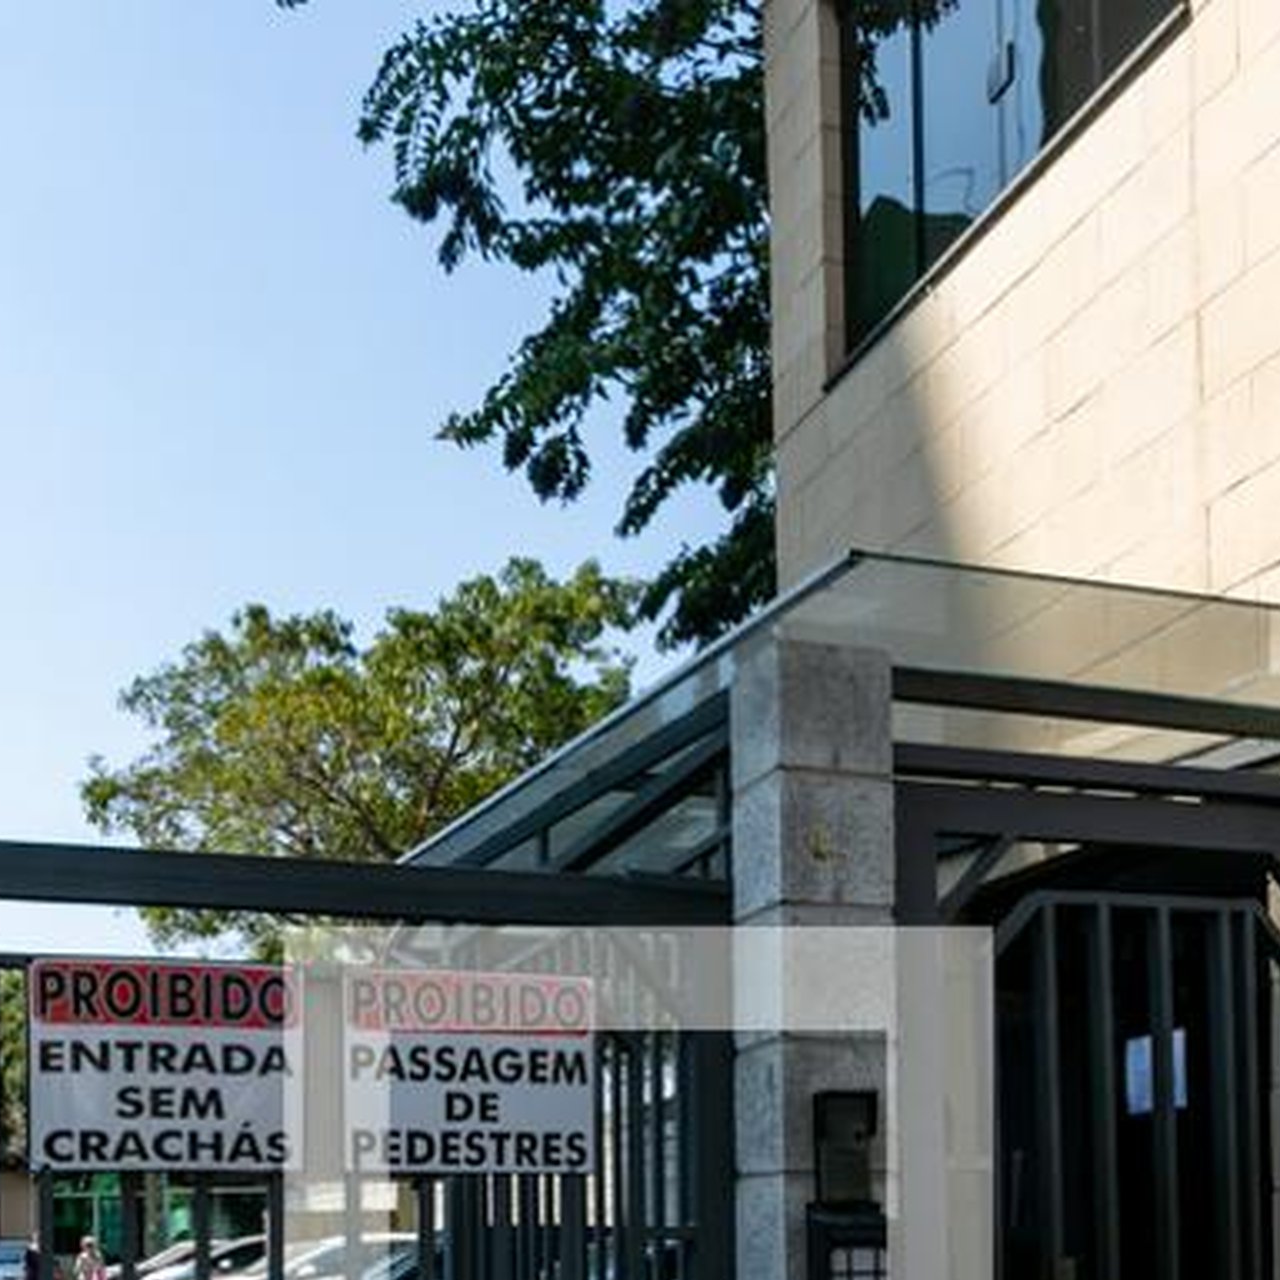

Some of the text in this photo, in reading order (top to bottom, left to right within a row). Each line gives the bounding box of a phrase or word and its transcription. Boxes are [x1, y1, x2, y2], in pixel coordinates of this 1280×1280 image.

[38, 970, 293, 1022] PROIBIDO
[352, 980, 585, 1028] PROIBIDO
[38, 1040, 293, 1076] ENTRADA
[350, 1045, 588, 1085] PASSAGEM
[116, 1086, 225, 1120] SEM
[445, 1091, 501, 1123] DE
[43, 1121, 291, 1163] CRACHÁS
[352, 1130, 588, 1168] PEDESTRES
